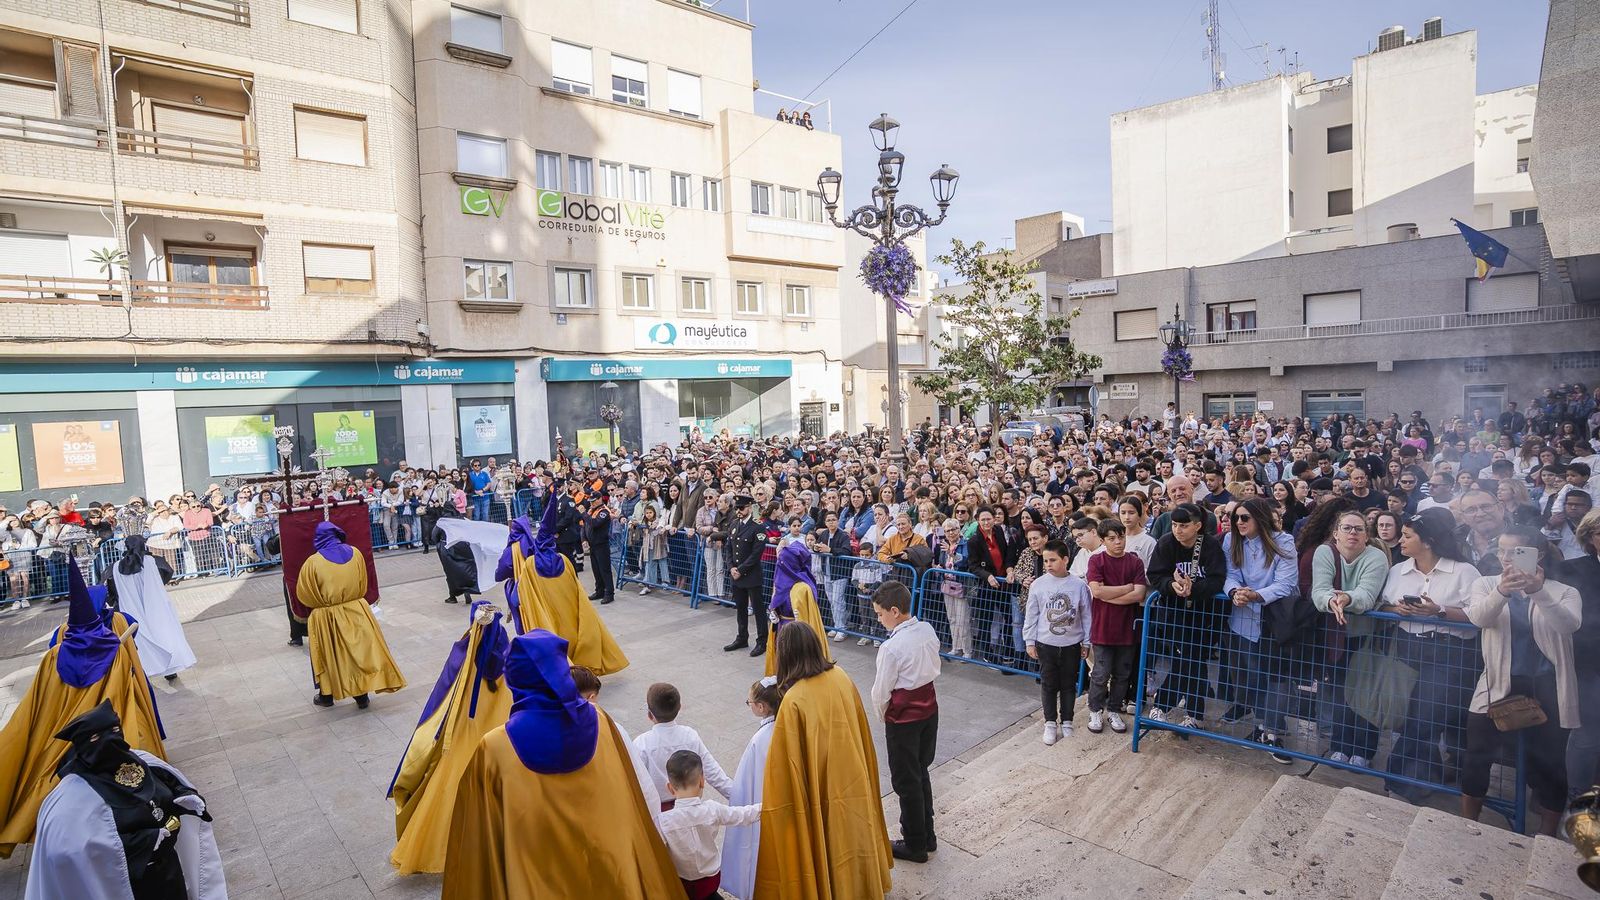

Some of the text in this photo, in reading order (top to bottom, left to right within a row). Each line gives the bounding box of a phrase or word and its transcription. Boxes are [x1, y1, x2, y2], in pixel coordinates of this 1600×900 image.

[463, 187, 509, 218] GV
[539, 190, 621, 225] Global
[538, 219, 666, 241] CORREDURÍA DE SEGUROS
[684, 323, 747, 340] mayéutica
[202, 368, 268, 383] cajamar
[413, 365, 464, 379] cajamar
[605, 364, 644, 376] cajamar
[729, 364, 761, 374] cajamar
